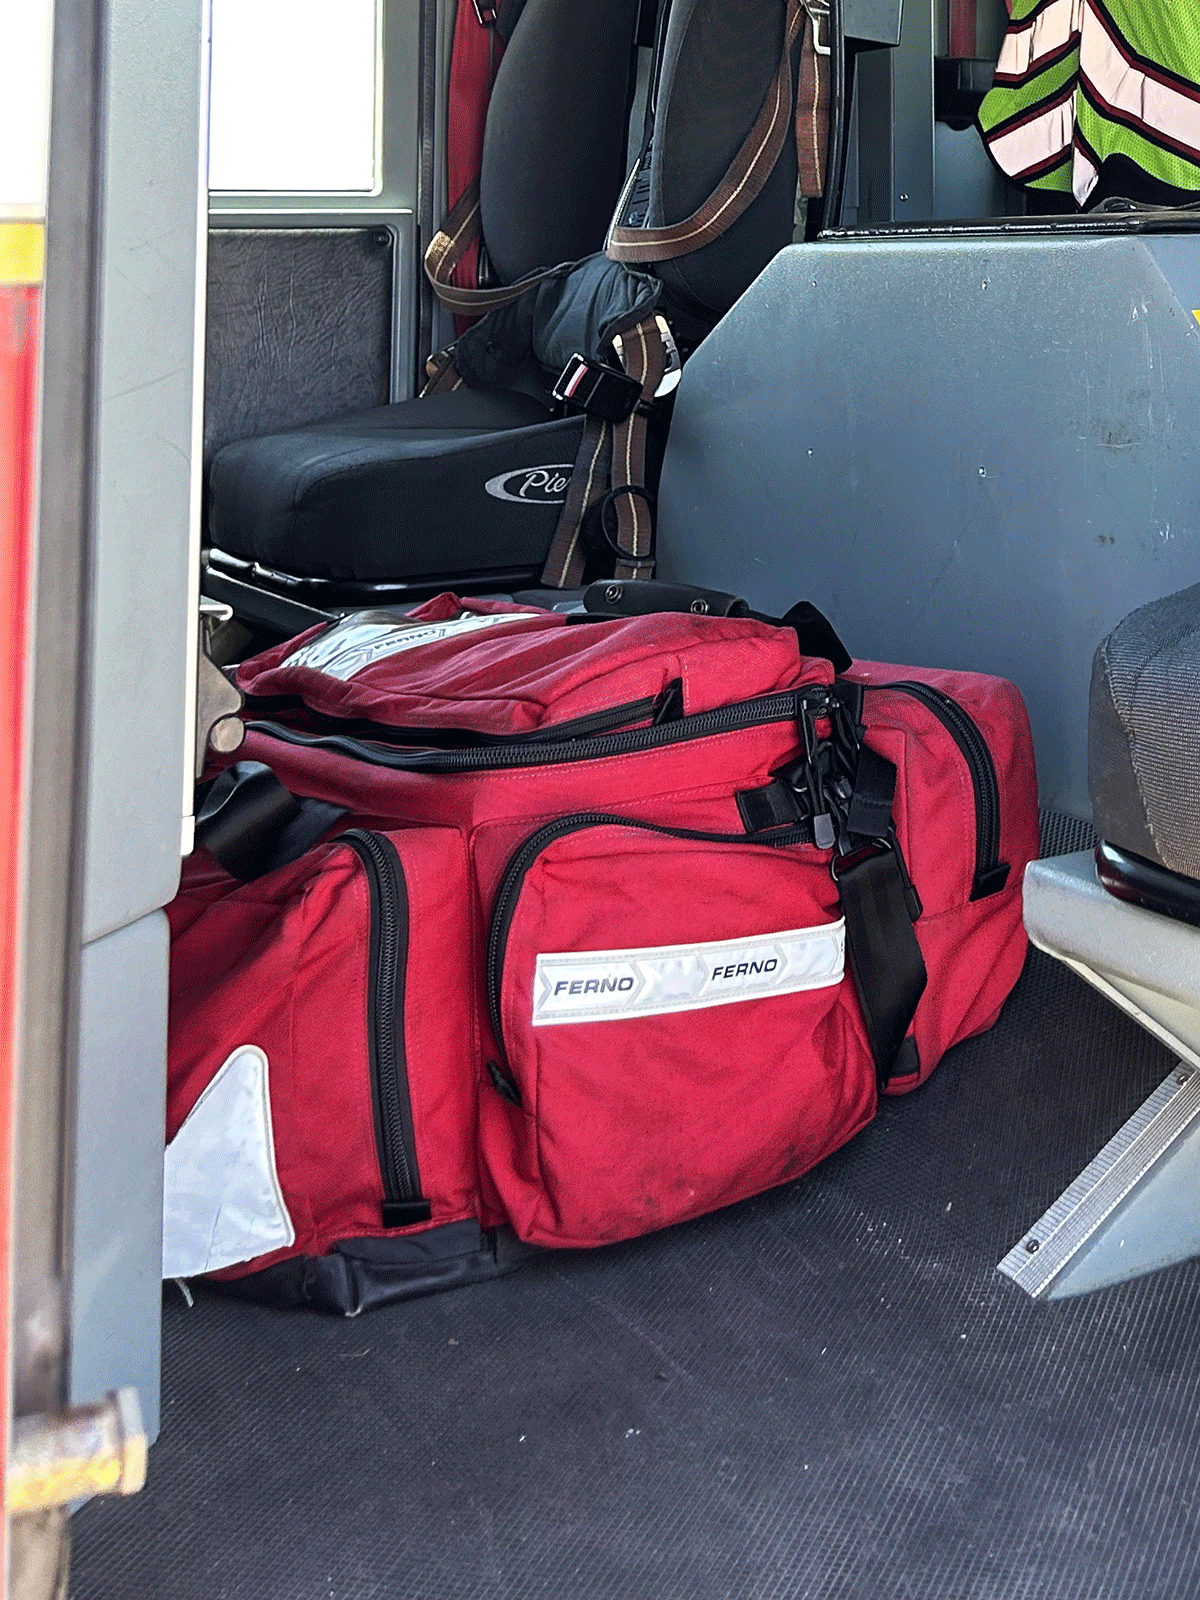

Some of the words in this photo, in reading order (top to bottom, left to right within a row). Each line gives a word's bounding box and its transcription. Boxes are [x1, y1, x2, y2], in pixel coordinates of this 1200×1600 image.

[519, 470, 572, 497] Pie
[374, 629, 437, 650] FERNO
[711, 958, 778, 981] FERNO
[553, 975, 635, 997] FERNO
